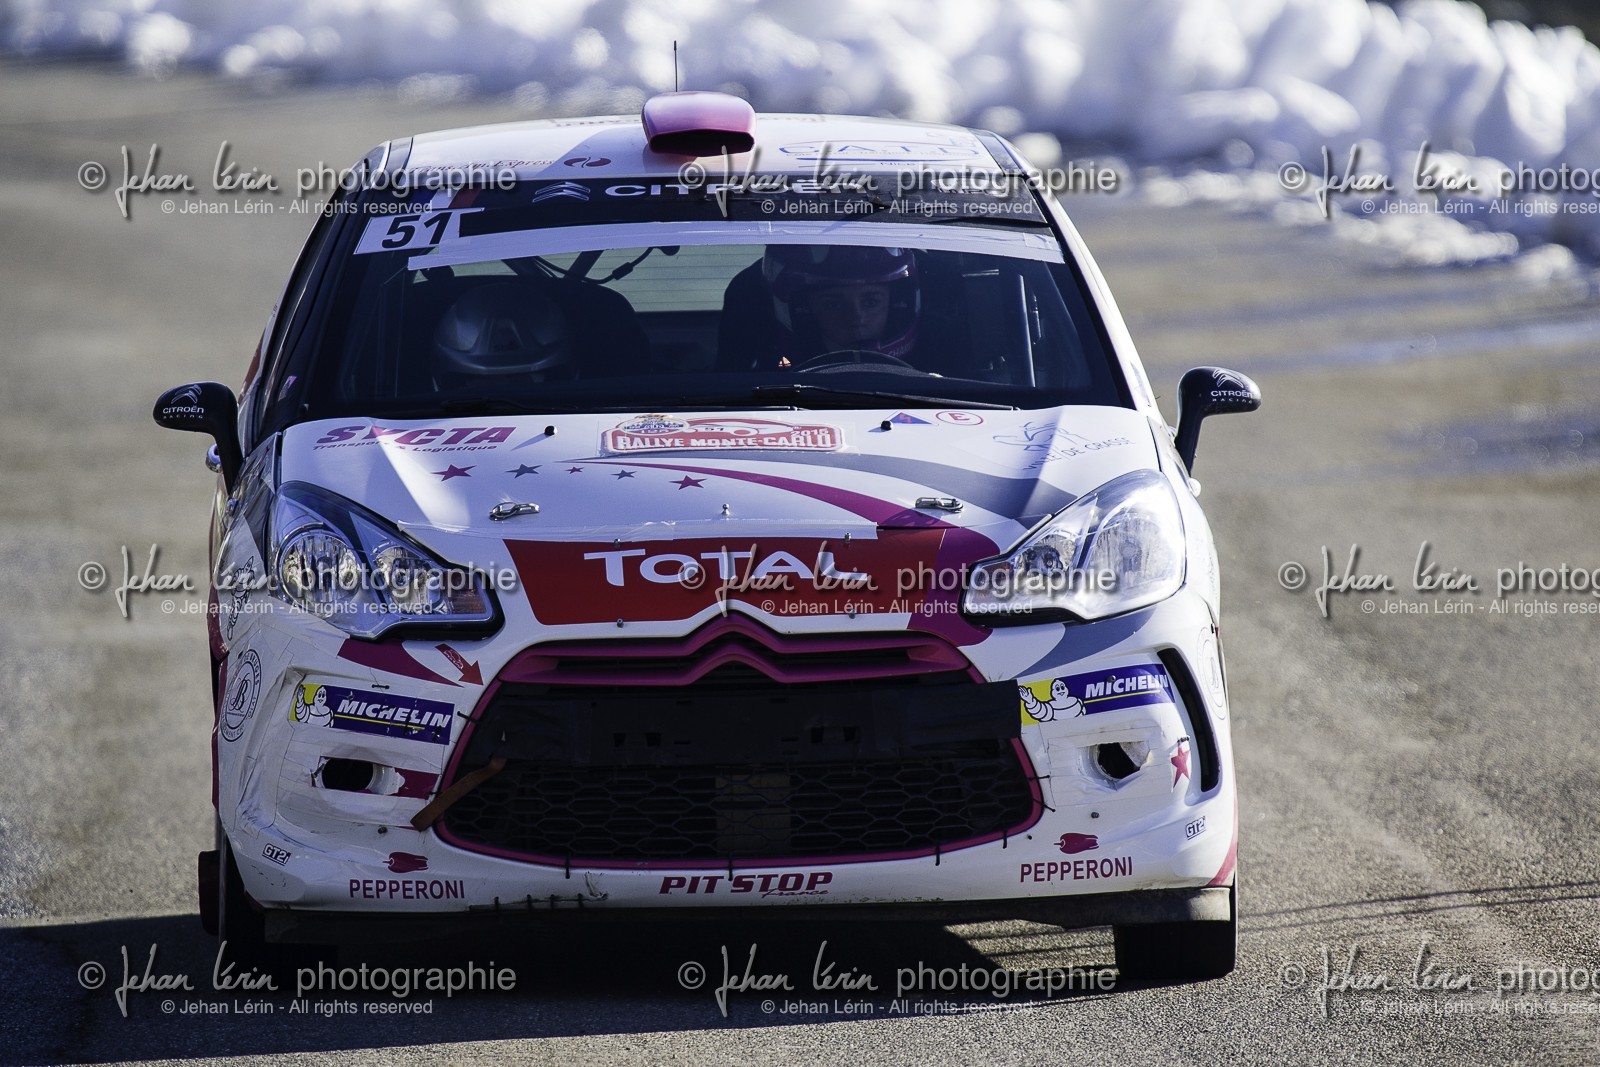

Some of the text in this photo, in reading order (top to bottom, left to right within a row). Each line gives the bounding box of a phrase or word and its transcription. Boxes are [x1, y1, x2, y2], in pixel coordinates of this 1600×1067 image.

[381, 212, 453, 249] 51
[412, 444, 497, 453] Logistique
[616, 434, 832, 449] RALLYE MONTE-CARLO
[1061, 446, 1086, 457] DE
[1084, 436, 1137, 451] GRASSE
[584, 548, 868, 587] TOTAL
[1084, 674, 1169, 699] MICHELIN
[336, 699, 452, 728] MICHELIN
[1019, 856, 1133, 883] PEPPERONI
[349, 878, 465, 899] PEPPERONI
[659, 871, 833, 895] PIT STOP
